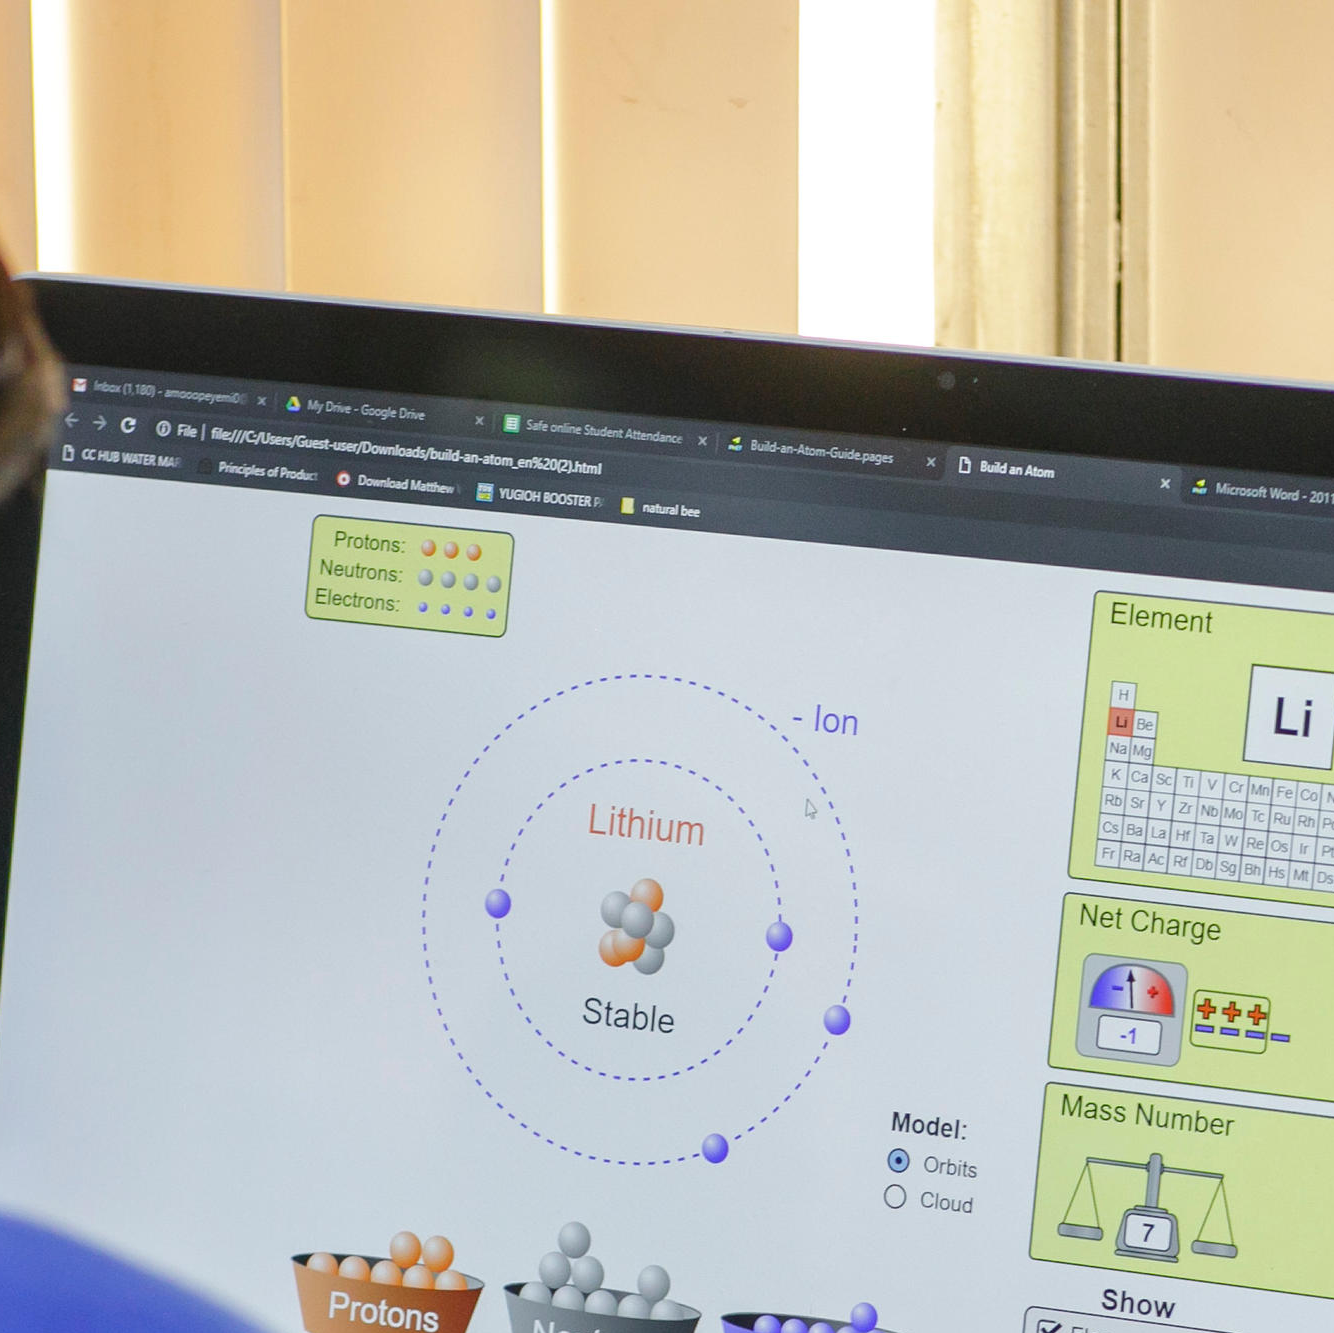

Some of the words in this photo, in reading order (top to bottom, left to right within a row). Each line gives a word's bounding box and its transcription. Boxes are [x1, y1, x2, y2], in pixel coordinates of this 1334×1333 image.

[94, 380, 121, 393] Inbox
[307, 399, 323, 414] My
[325, 400, 351, 414] Drive
[360, 404, 397, 420] Google
[399, 408, 426, 421] Drive
[177, 423, 197, 438] File
[526, 418, 549, 432] Safe
[550, 420, 582, 435] online
[584, 423, 624, 439] Student
[81, 448, 96, 461] CC
[98, 450, 120, 463] HUB
[122, 452, 156, 467] WATER
[750, 439, 894, 466] Build-an-Atom-Guide.pages
[219, 461, 265, 479] Principles
[267, 465, 279, 478] of
[980, 460, 1007, 475] Build
[1008, 465, 1023, 476] an
[1024, 464, 1055, 479] Atom
[358, 474, 409, 491] Download
[410, 478, 455, 495] Matthew
[1216, 482, 1267, 499] Microsoft
[1269, 487, 1299, 501] Word
[499, 486, 542, 503] YUGIOH
[543, 490, 591, 508] BOOSTER
[642, 503, 678, 516] natural
[680, 505, 701, 519] bee
[334, 531, 406, 554] Protons:
[320, 558, 403, 583] Neutrons:
[315, 587, 400, 612] Electrons:
[1110, 601, 1214, 634] Element
[1119, 689, 1129, 701] H
[813, 703, 859, 736] Ion
[1116, 716, 1127, 728] Li
[1137, 718, 1153, 731] Be
[1274, 696, 1313, 738] Li
[1110, 742, 1127, 754] Na
[1133, 744, 1152, 760] Mg
[1111, 768, 1121, 780] K
[1131, 770, 1148, 783] Ca
[1156, 773, 1171, 786] Sc
[1183, 775, 1194, 788] Ti
[1207, 778, 1218, 790] V
[1229, 781, 1244, 793] Cr
[1251, 784, 1269, 796] Mn
[1277, 786, 1293, 799] Fe
[1300, 788, 1318, 802] Co
[1105, 794, 1122, 807] Rb
[1130, 797, 1145, 809] Sr
[1157, 800, 1167, 811] Y
[1178, 802, 1193, 814] Zr
[1201, 804, 1218, 817] Nb
[1224, 807, 1243, 820] Mo
[1251, 809, 1265, 822] Tc
[1273, 812, 1291, 825] Ru
[1297, 815, 1315, 828] Rh
[588, 803, 706, 846] Lithium
[1078, 903, 1122, 932] Net
[1131, 909, 1222, 945] Charge
[582, 997, 675, 1034] Stable
[1119, 1026, 1138, 1046] -1
[890, 1110, 968, 1141] Model:
[1060, 1093, 1127, 1125] Mass
[1135, 1101, 1236, 1137] Number
[923, 1154, 978, 1180] Orbits
[919, 1190, 974, 1214] Cloud
[1141, 1223, 1155, 1243] 7
[328, 1290, 439, 1333] Protons
[1101, 1288, 1176, 1318] Show
